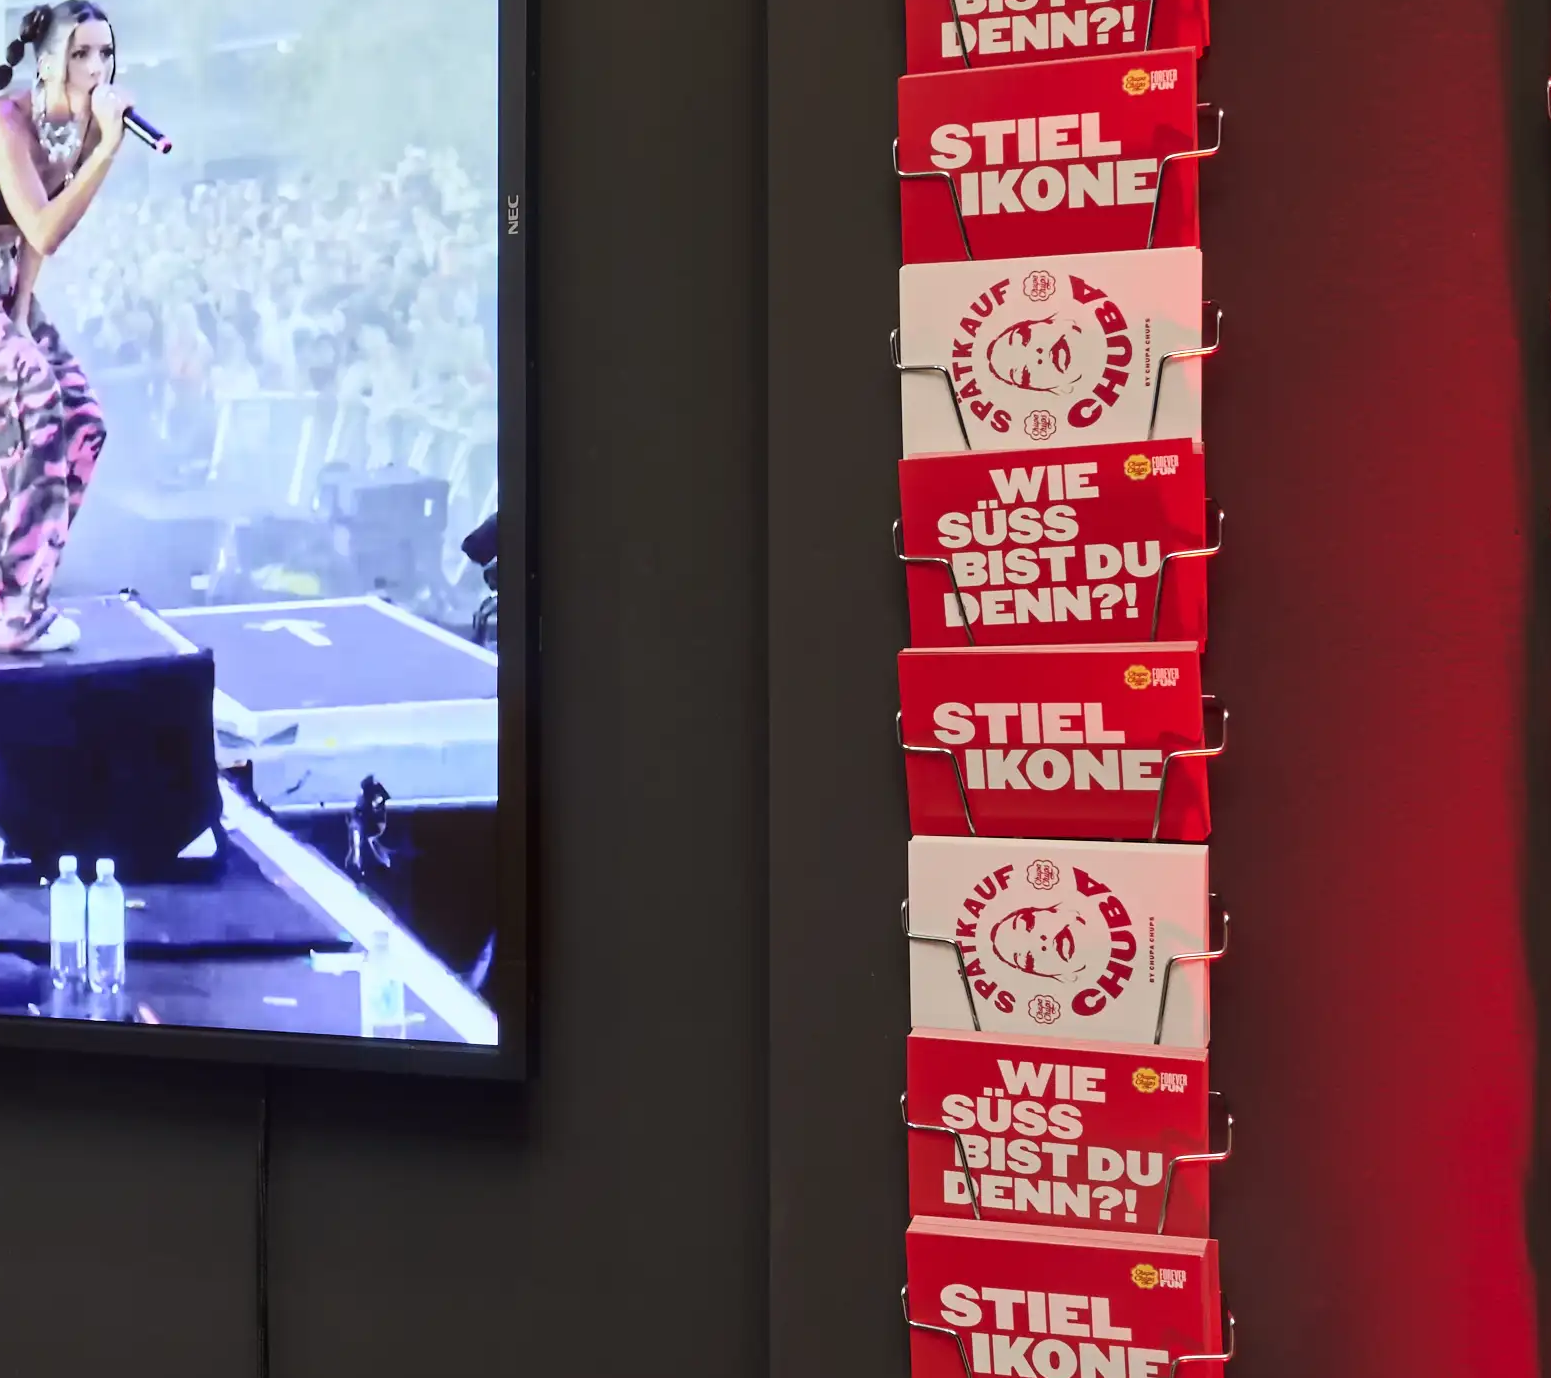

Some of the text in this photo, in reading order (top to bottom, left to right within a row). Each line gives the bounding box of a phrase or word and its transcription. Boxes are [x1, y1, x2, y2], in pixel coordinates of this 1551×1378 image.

[941, 6, 1136, 57] DENN?!
[508, 195, 519, 234] NEC
[952, 277, 1012, 434] SPÄTKAUF
[1067, 274, 1133, 429] CHUBA
[933, 702, 1125, 745] STIEL
[965, 749, 1163, 791] IKONE
[1070, 867, 1138, 1017] CHUBA
[939, 1284, 1132, 1341] STIEL
